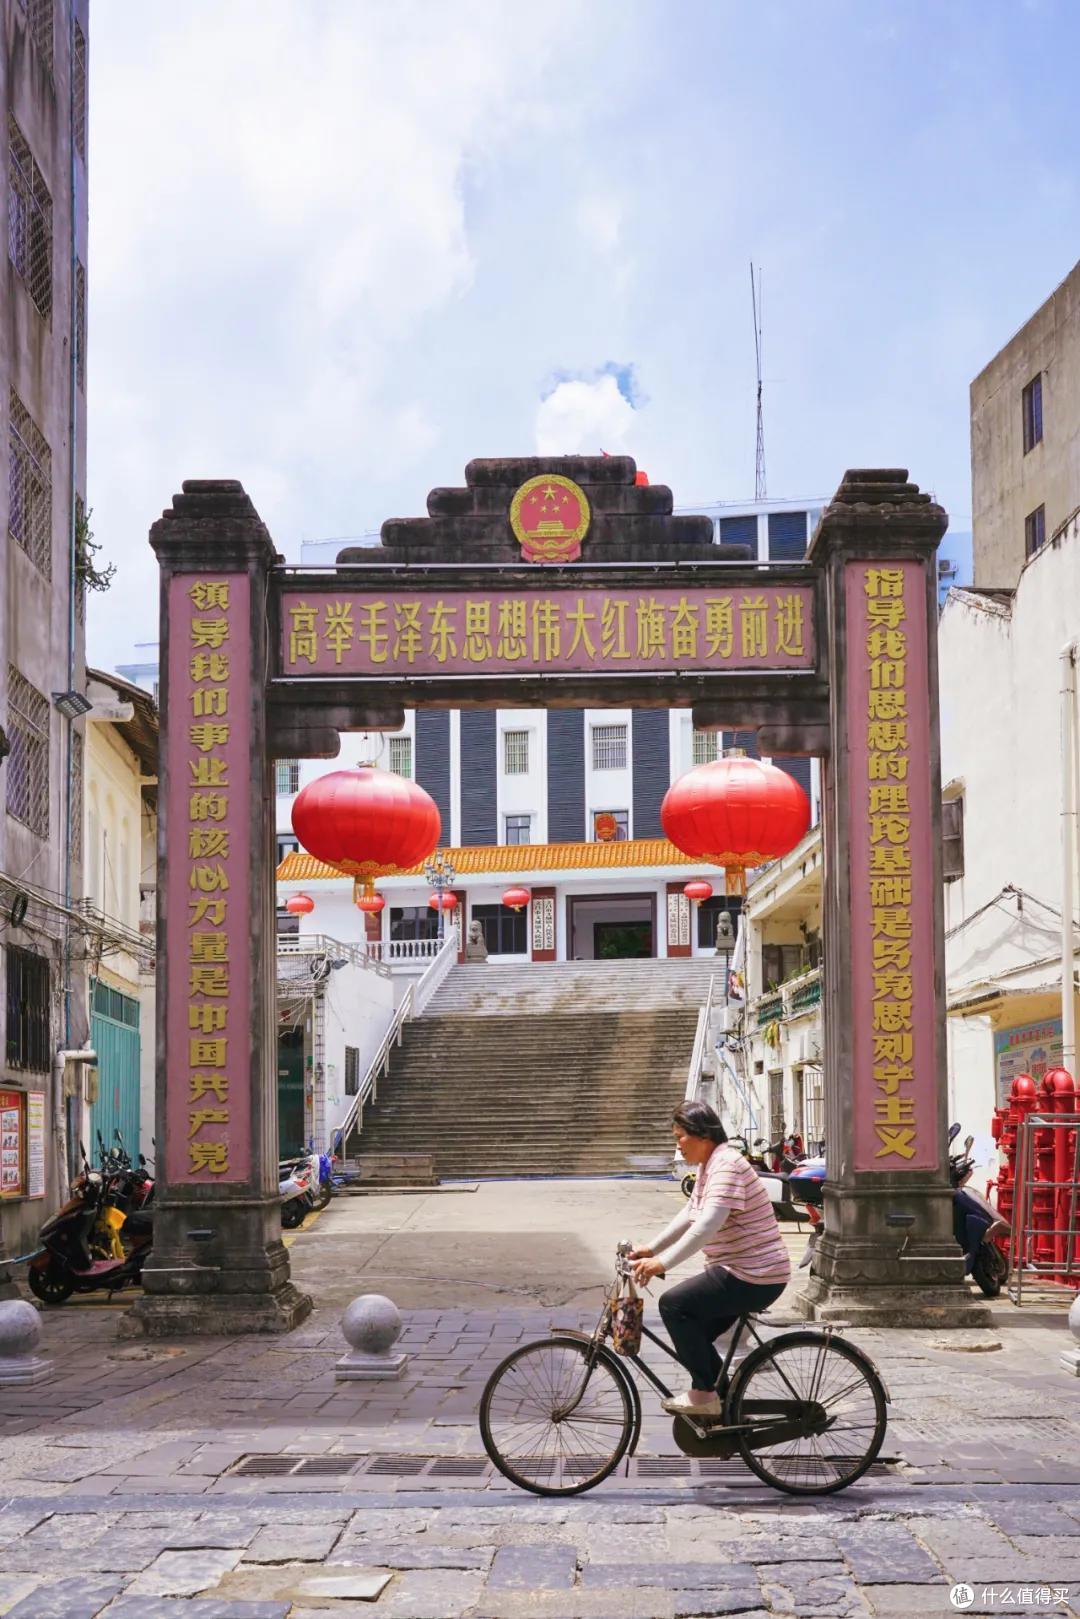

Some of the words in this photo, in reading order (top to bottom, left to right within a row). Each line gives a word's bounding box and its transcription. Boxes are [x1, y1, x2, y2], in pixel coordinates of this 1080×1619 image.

[288, 594, 806, 665] 高举毛泽东思想伟大红旗奋勇前进
[864, 568, 917, 1161] 指导我们思想的理论基础是马克思列宁主义
